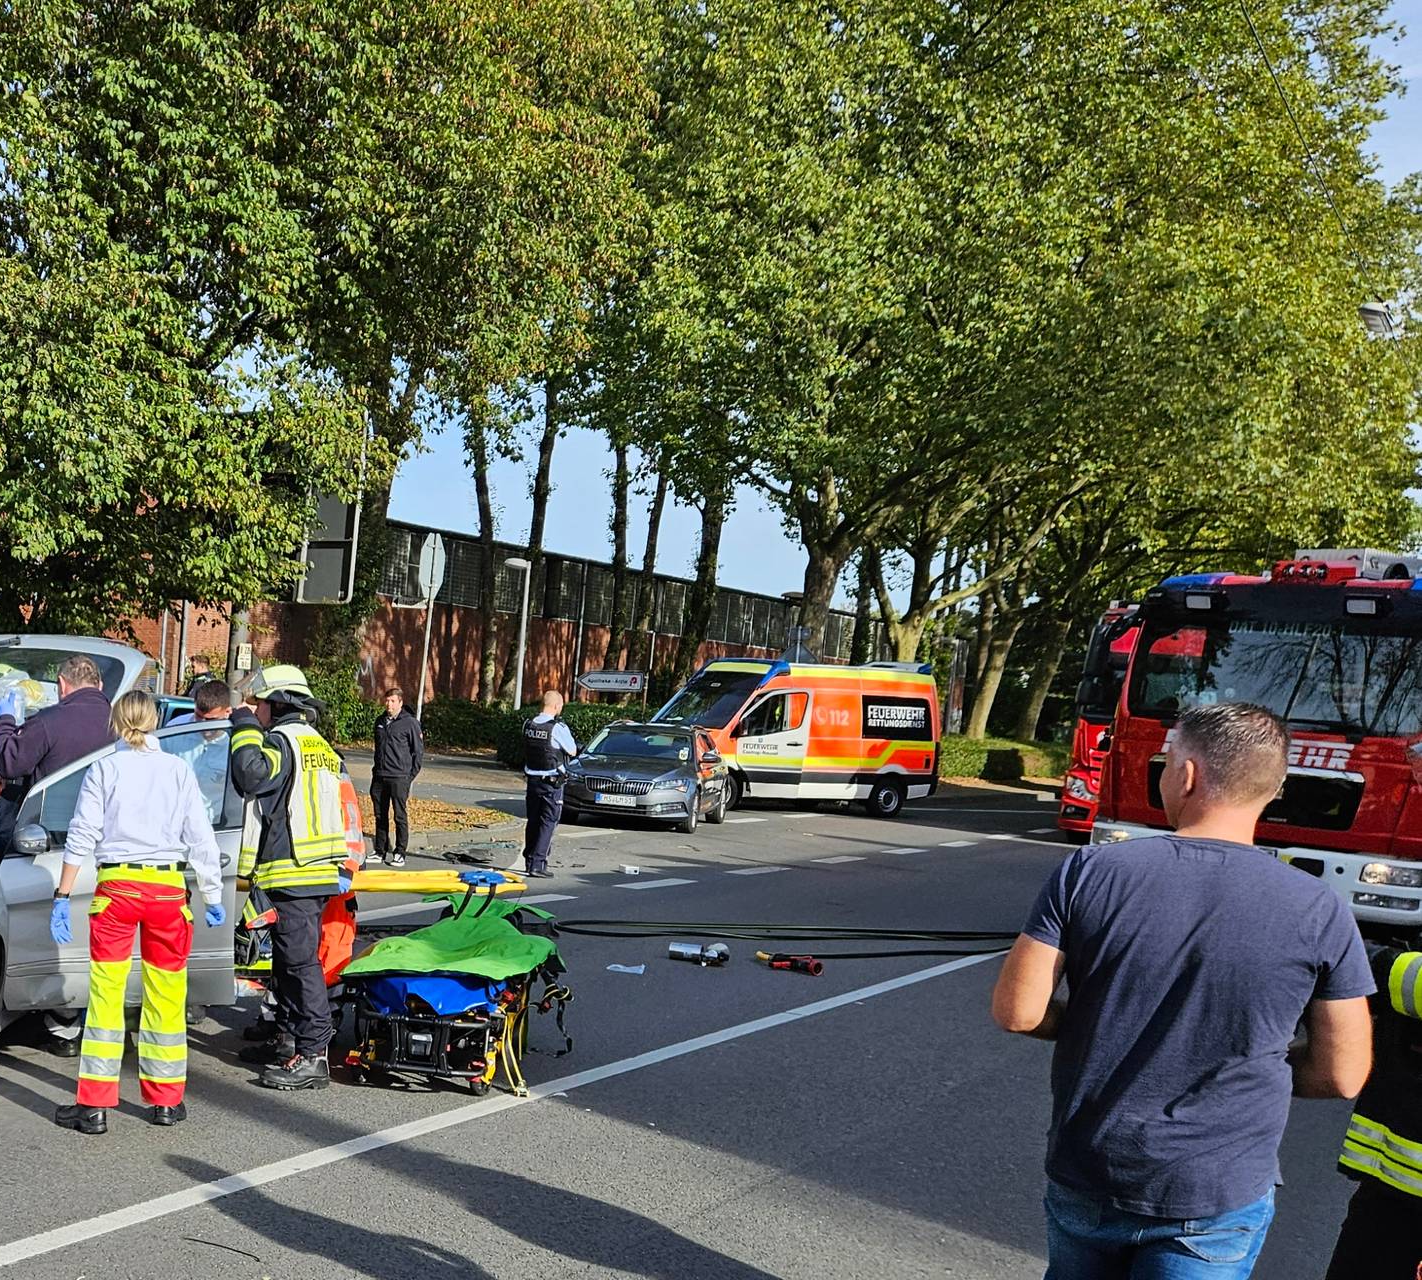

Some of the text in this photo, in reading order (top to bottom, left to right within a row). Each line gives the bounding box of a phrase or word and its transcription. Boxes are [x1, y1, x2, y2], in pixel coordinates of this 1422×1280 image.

[830, 709, 850, 726] 112
[868, 705, 925, 720] FEUERWEHR
[868, 719, 926, 728] RETTUNGSDIENST
[525, 729, 548, 739] POLIZEI
